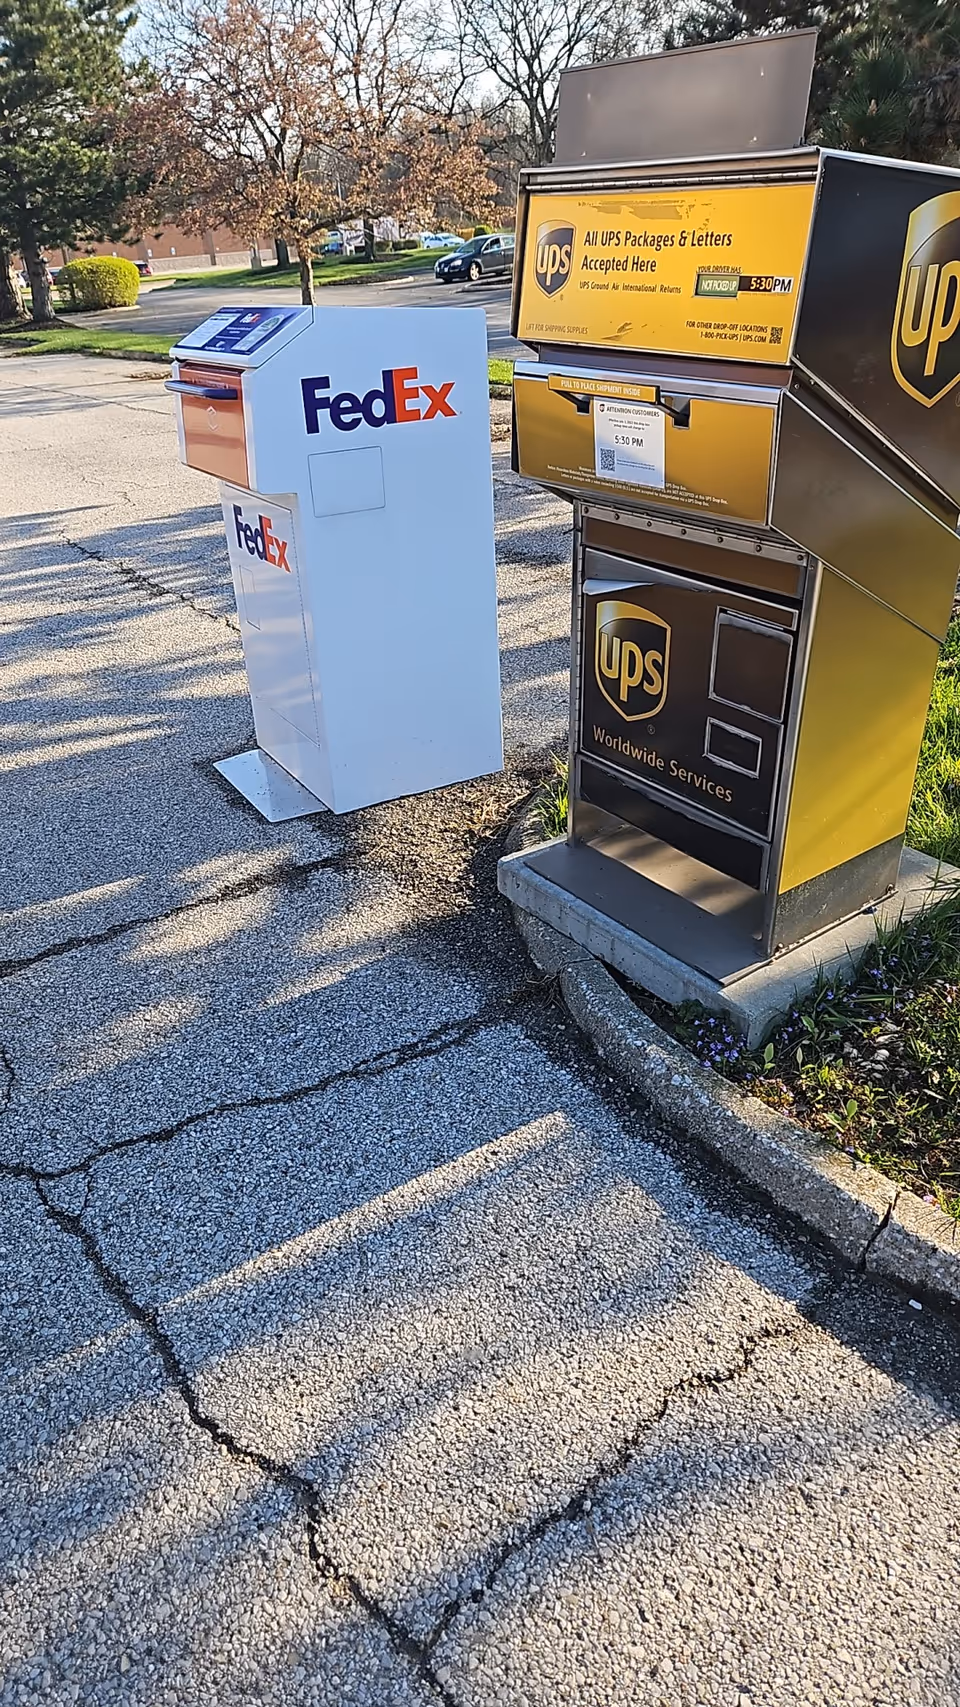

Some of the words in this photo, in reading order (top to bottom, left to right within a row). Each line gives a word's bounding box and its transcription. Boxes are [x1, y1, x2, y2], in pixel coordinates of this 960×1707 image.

[584, 230, 598, 247] All
[601, 231, 621, 247] UPS
[624, 231, 675, 251] Packages
[678, 230, 688, 247] &
[691, 230, 732, 247] Letters
[536, 245, 570, 286] ups
[581, 255, 629, 275] Accepted
[631, 255, 657, 273] Here
[580, 281, 590, 290] UPS
[591, 282, 609, 291] Ground
[612, 282, 620, 291] Air
[622, 283, 657, 293] International
[659, 285, 682, 294] Returns
[701, 280, 713, 291] NOT
[750, 277, 773, 290] 5:30
[773, 279, 792, 292] PM
[686, 320, 696, 328] FOR
[697, 321, 712, 330] OTHER
[713, 322, 739, 331] DROP-OFF
[740, 324, 768, 333] LOCATIONS
[901, 260, 960, 376] up
[535, 324, 544, 332] FOR
[545, 324, 566, 333] SHIPPING
[567, 325, 588, 334] SUPPLIES
[701, 332, 739, 341] 1-800-PICK-UPS
[743, 335, 767, 343] UPS.COM
[561, 380, 572, 388] PULL
[573, 381, 580, 389] TO
[581, 382, 596, 391] PLACE
[597, 384, 622, 394] SHIPMENT
[623, 387, 641, 396] INSIDE
[300, 366, 458, 435] FedEx
[607, 406, 631, 414] ATTENTION
[632, 409, 660, 418] CUSTOMERS
[615, 435, 630, 445] 5:30
[632, 438, 644, 447] PM
[232, 504, 292, 573] FedEx
[600, 633, 663, 702] ups
[593, 725, 665, 771] Worldwide
[669, 760, 733, 803] Services
